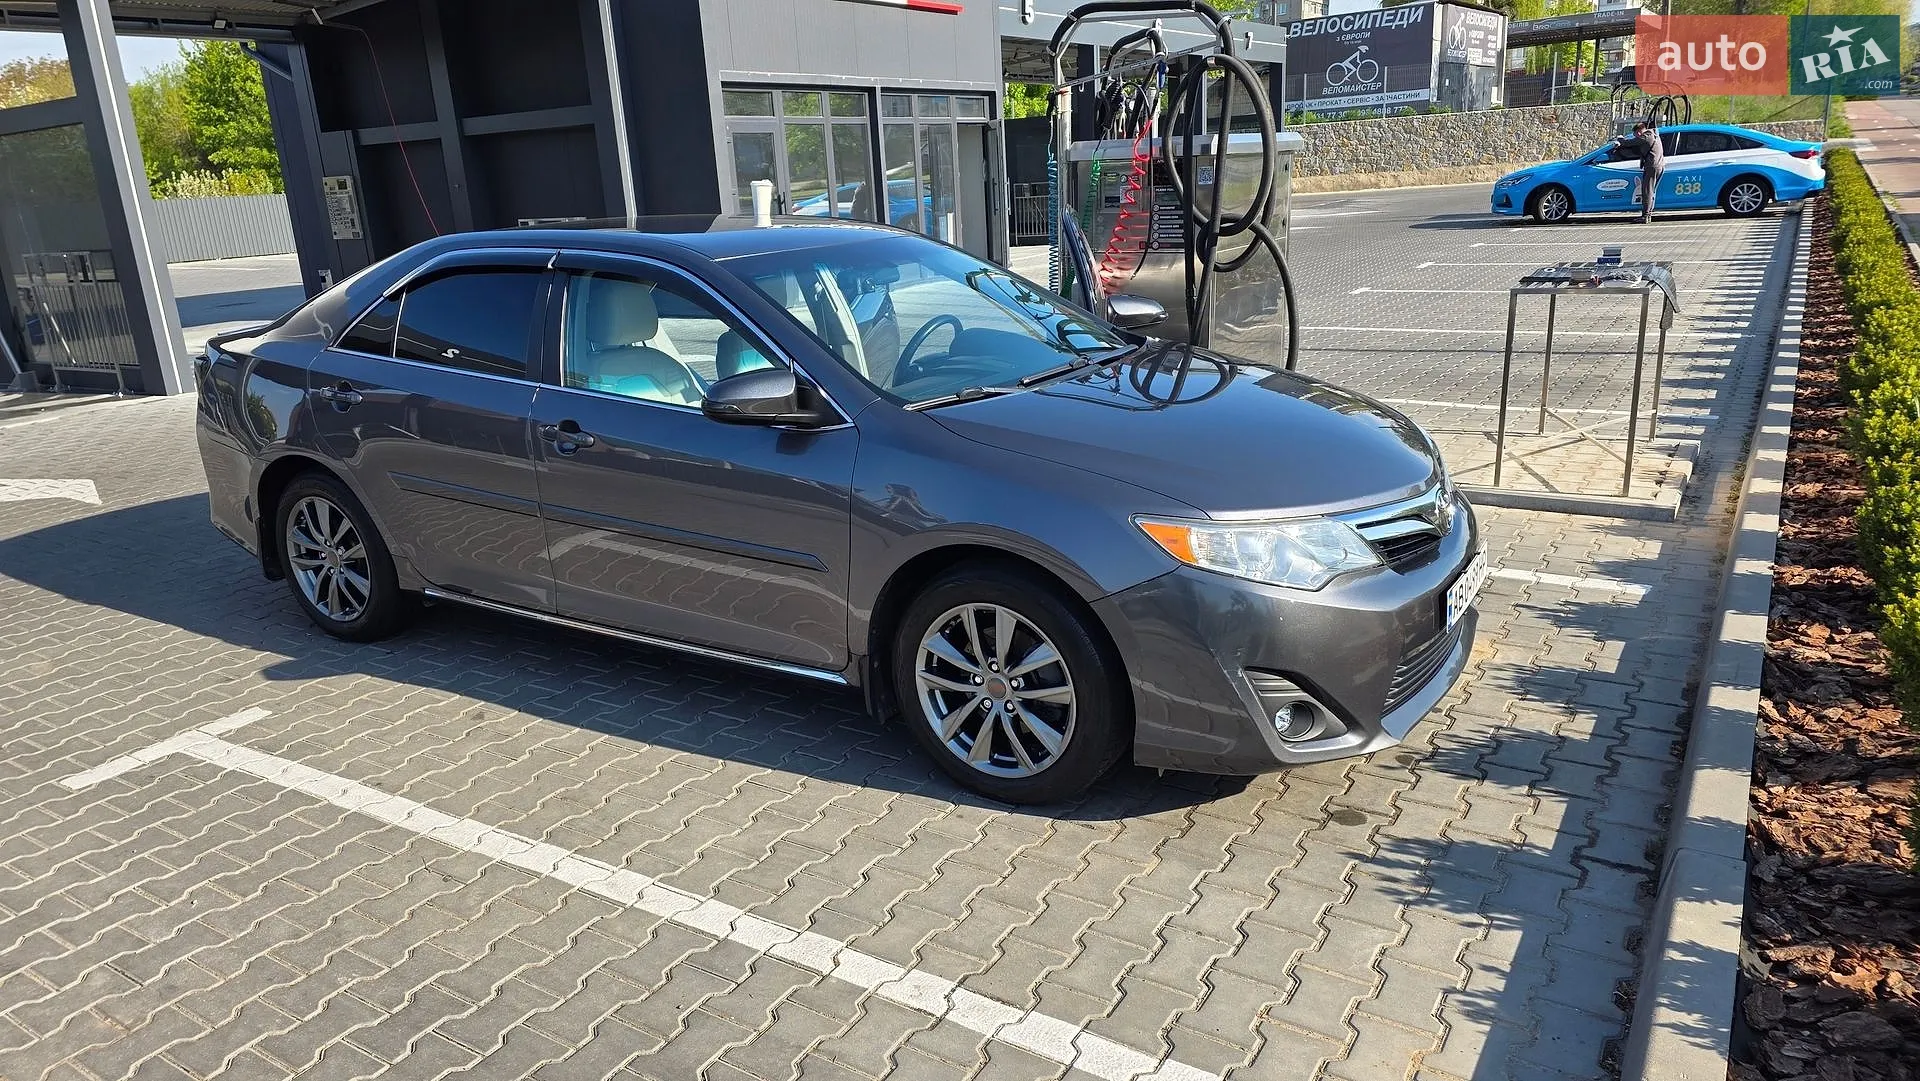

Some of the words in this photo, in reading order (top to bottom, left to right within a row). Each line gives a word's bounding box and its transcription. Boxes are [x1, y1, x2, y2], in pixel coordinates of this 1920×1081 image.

[1021, 0, 1034, 25] 5
[1289, 6, 1425, 38] ВЕЛОСИПЕДИ
[1245, 31, 1253, 50] 7
[1341, 31, 1371, 41] ЄВРОПИ
[1322, 82, 1381, 95] ВЕЛОМАЙСТЕР
[1317, 99, 1341, 107] ПРОКАТ
[1347, 96, 1370, 105] СЕРВІС
[1675, 182, 1701, 195] 838
